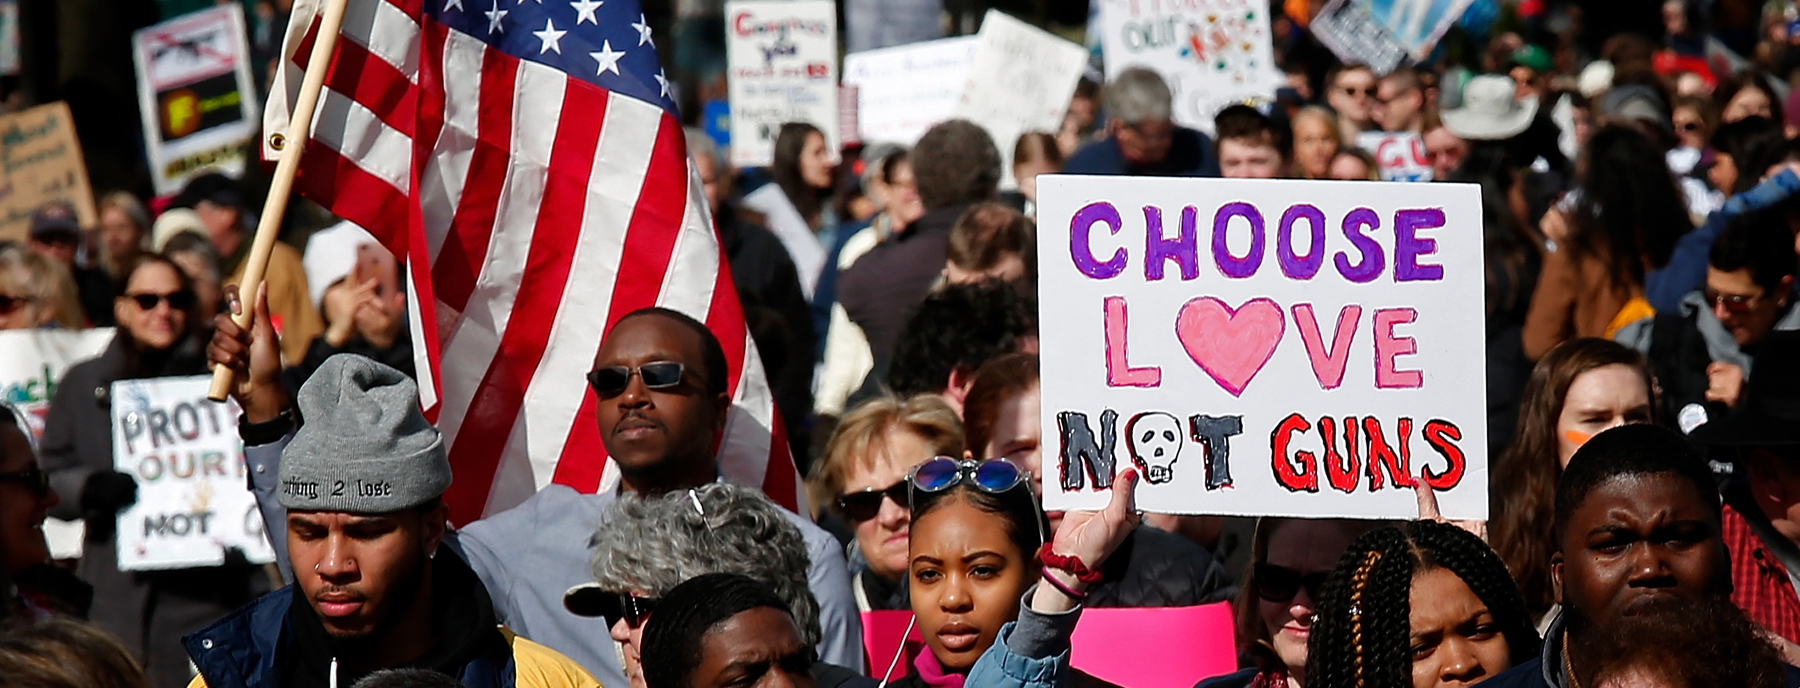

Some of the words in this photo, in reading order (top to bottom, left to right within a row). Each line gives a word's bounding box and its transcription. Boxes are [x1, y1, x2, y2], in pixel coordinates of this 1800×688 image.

[1069, 201, 1447, 283] CHOOSE
[121, 399, 241, 455] PROT
[139, 451, 226, 482] OUR
[1270, 413, 1467, 494] GUNS
[331, 480, 345, 496] 2
[357, 480, 392, 497] lose
[143, 510, 213, 537] NOT
